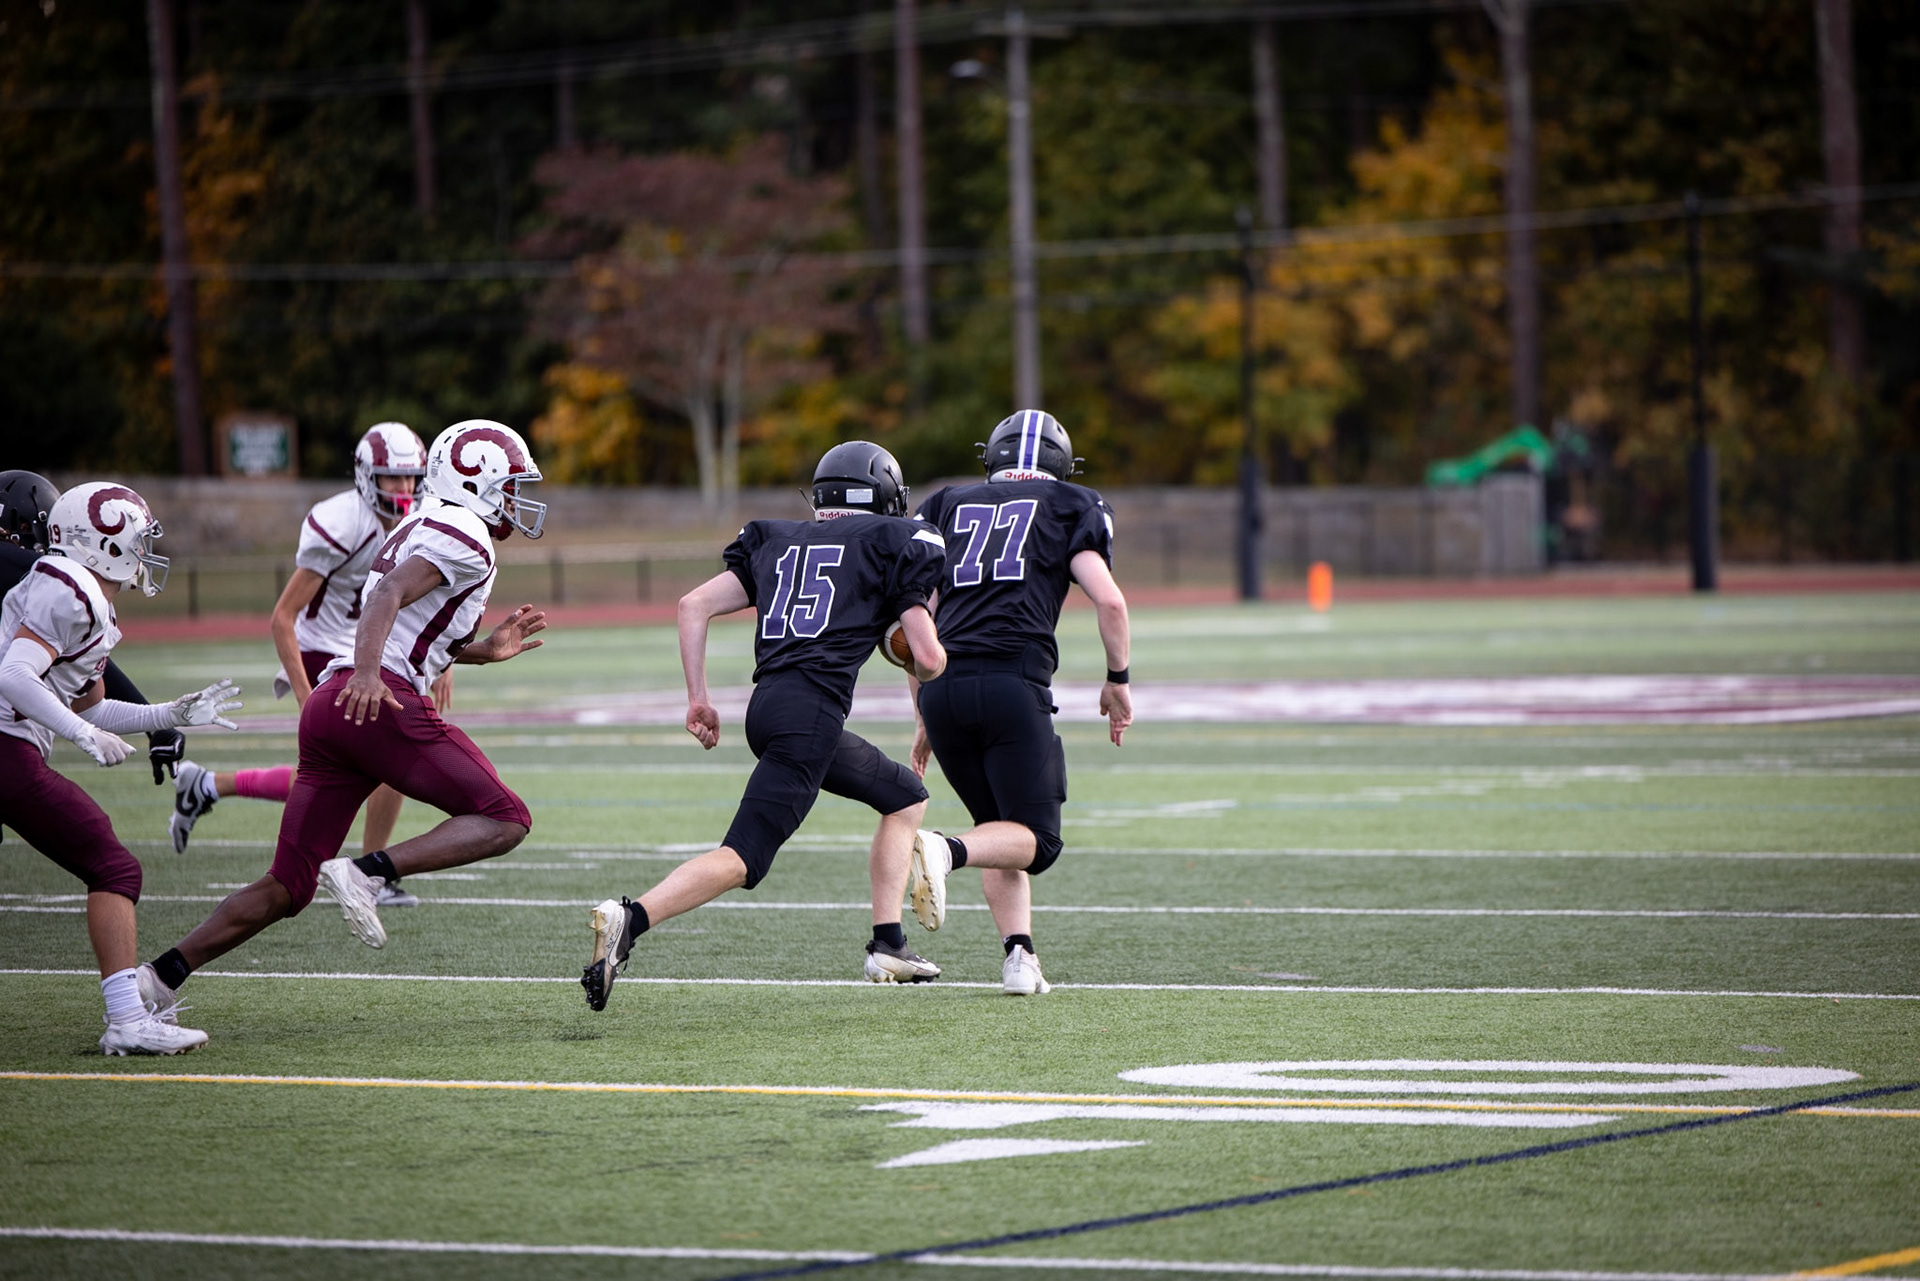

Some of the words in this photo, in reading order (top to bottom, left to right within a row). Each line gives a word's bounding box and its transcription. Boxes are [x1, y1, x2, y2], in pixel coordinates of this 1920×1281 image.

[48, 523, 61, 544] 19
[953, 499, 1038, 587] 77
[762, 545, 845, 639] 15
